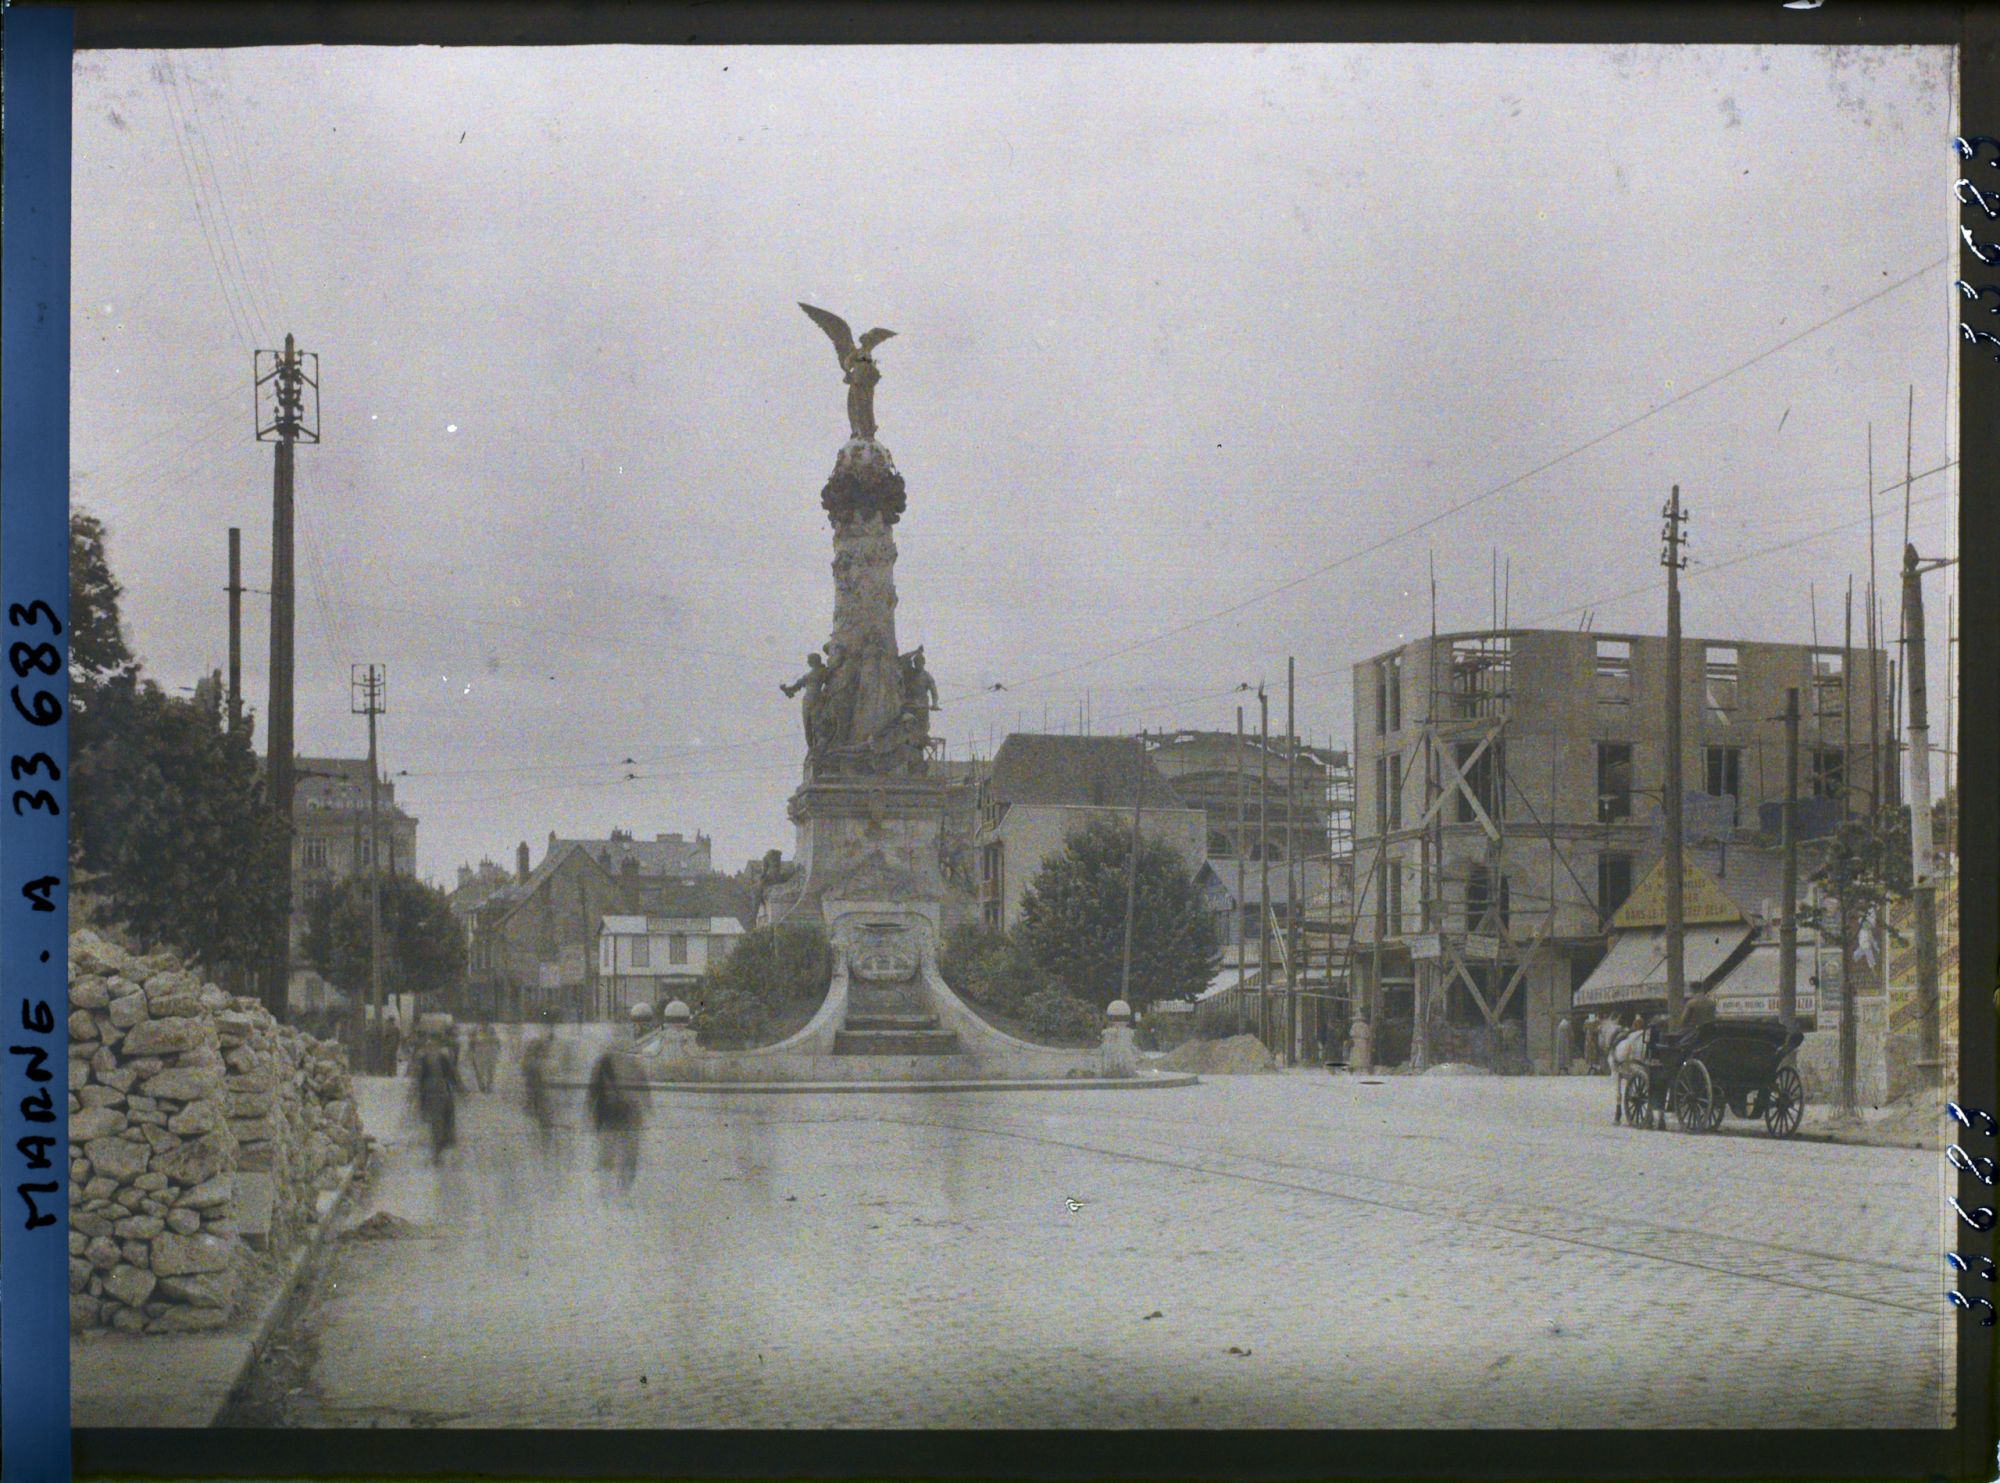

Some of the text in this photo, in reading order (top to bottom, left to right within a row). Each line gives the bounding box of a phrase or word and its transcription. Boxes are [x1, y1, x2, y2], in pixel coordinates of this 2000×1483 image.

[22, 875, 60, 913] A
[9, 998, 59, 1231] MARNE
[1947, 1102, 1997, 1327] 33683
